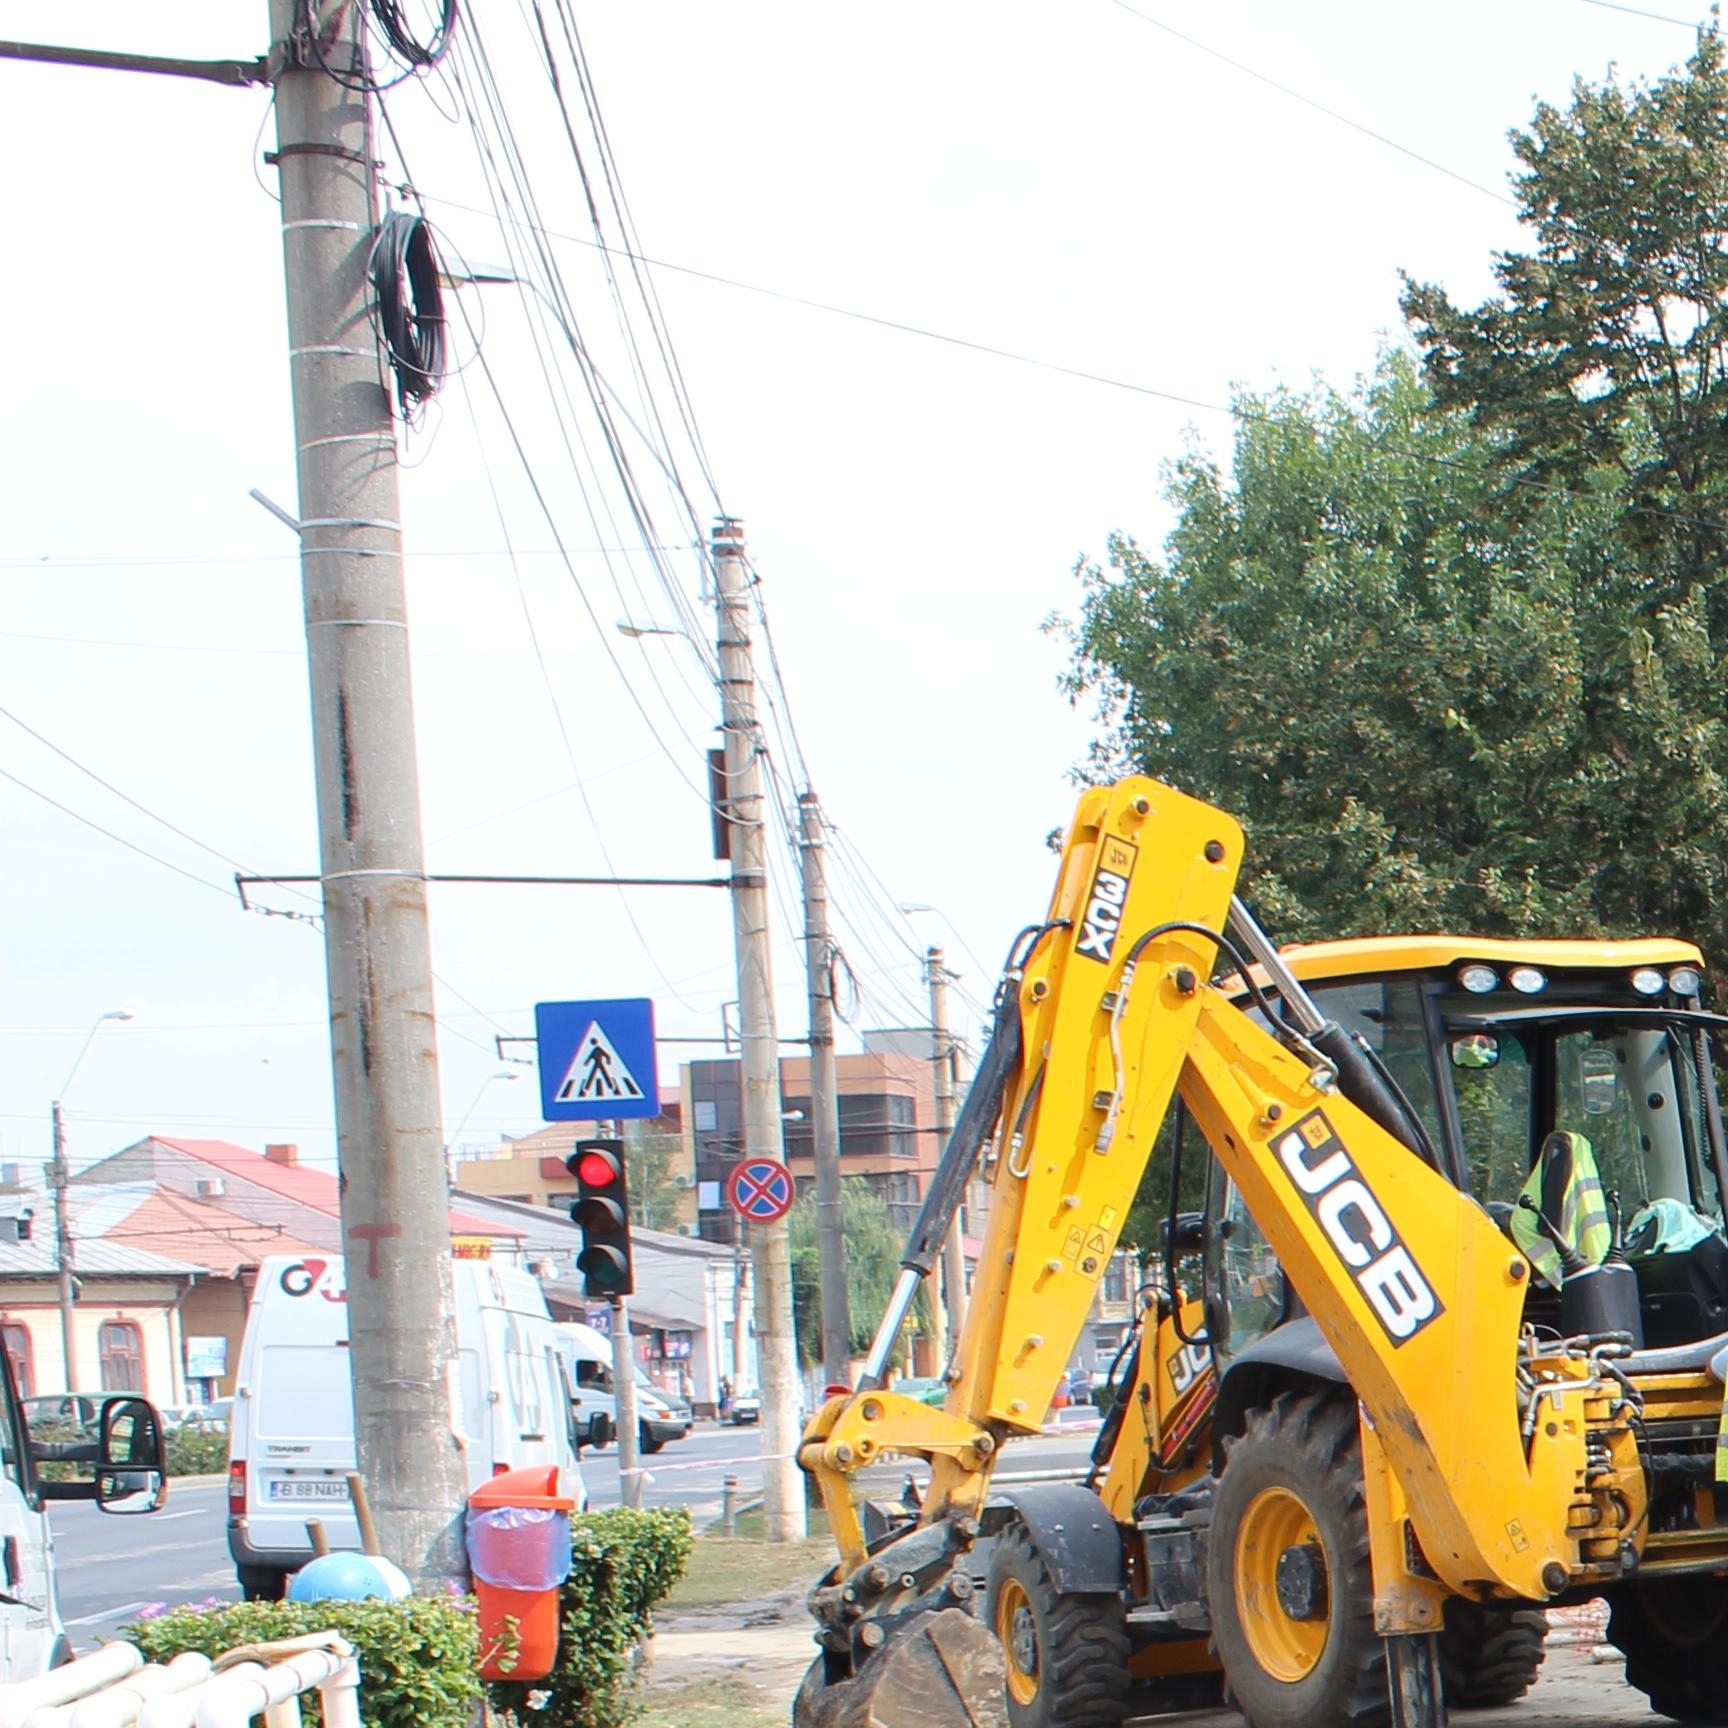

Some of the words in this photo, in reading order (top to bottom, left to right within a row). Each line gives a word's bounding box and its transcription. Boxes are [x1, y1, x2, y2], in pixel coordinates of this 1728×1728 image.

[1077, 871, 1127, 960] 3CX
[1280, 1131, 1436, 1338] JCB
[280, 1259, 347, 1303] G4
[1174, 1328, 1212, 1391] JC
